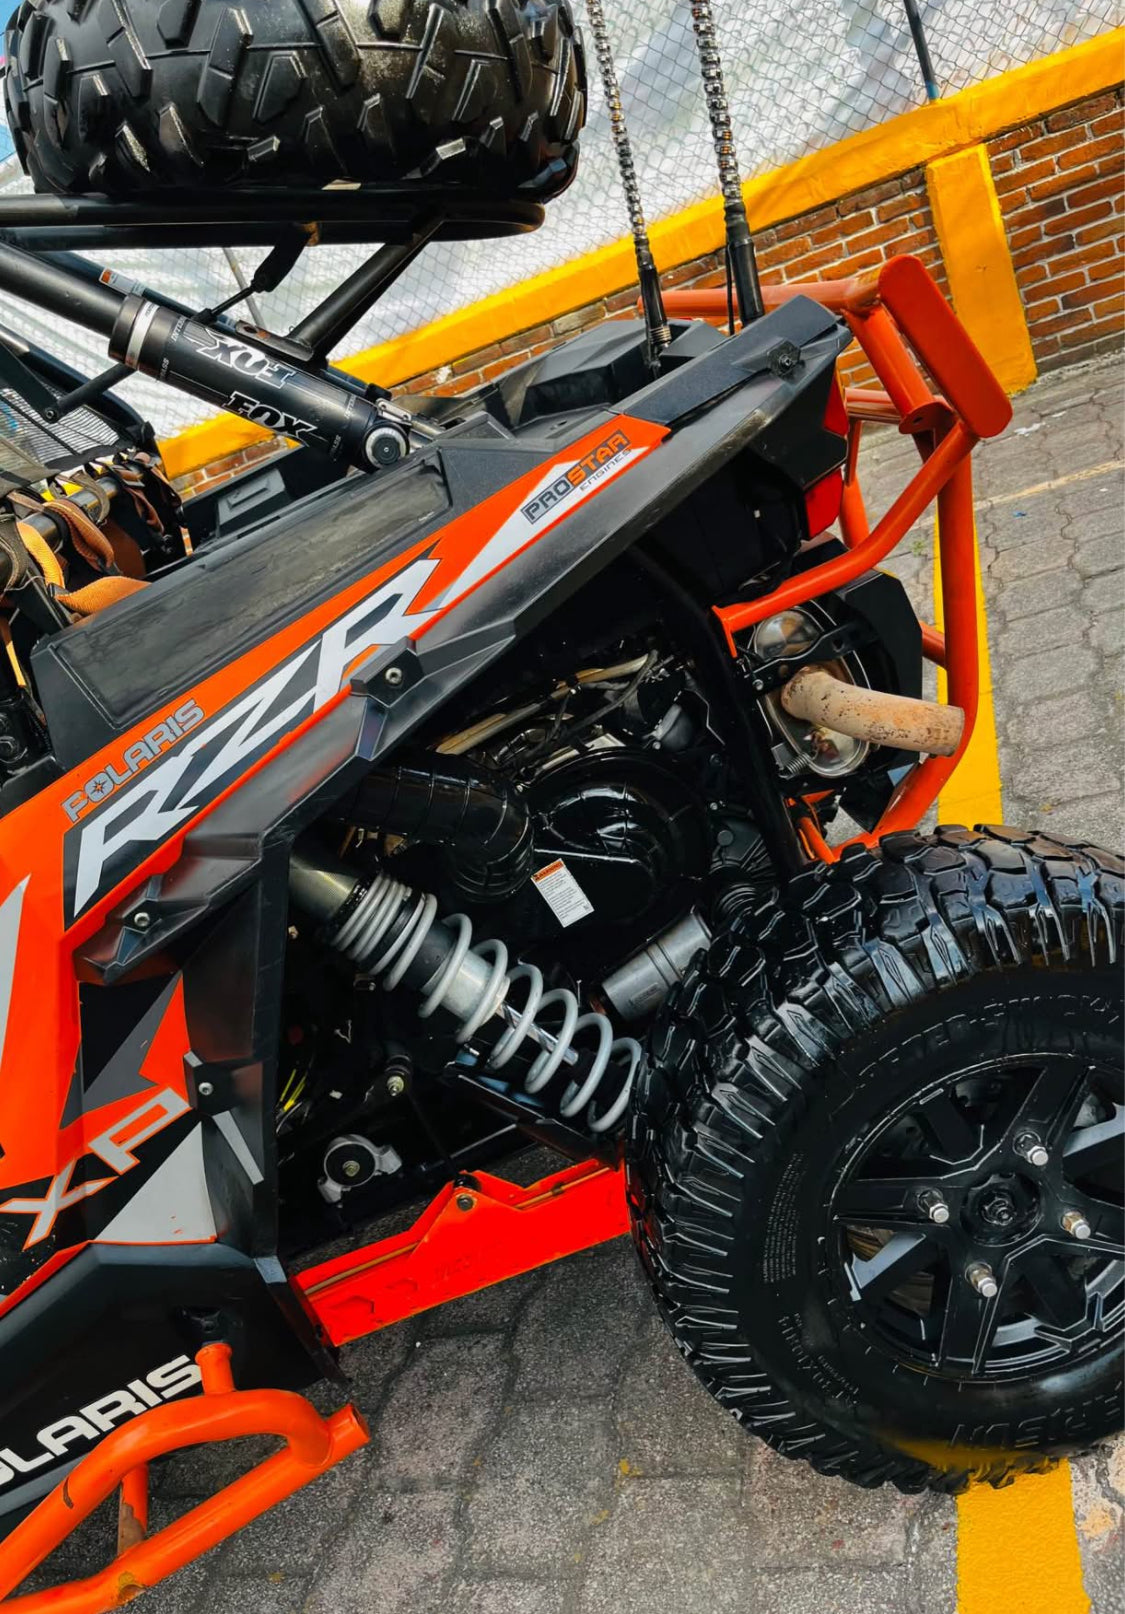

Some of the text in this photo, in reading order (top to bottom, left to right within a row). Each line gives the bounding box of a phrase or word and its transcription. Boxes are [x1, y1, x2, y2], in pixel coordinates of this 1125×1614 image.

[196, 328, 296, 389] FOX
[221, 390, 318, 447] FOX
[523, 432, 629, 521] PROSTAR
[579, 448, 632, 492] ENGINES
[61, 699, 207, 823] POLARIS
[73, 559, 444, 918] RZR
[0, 1087, 193, 1251] XP
